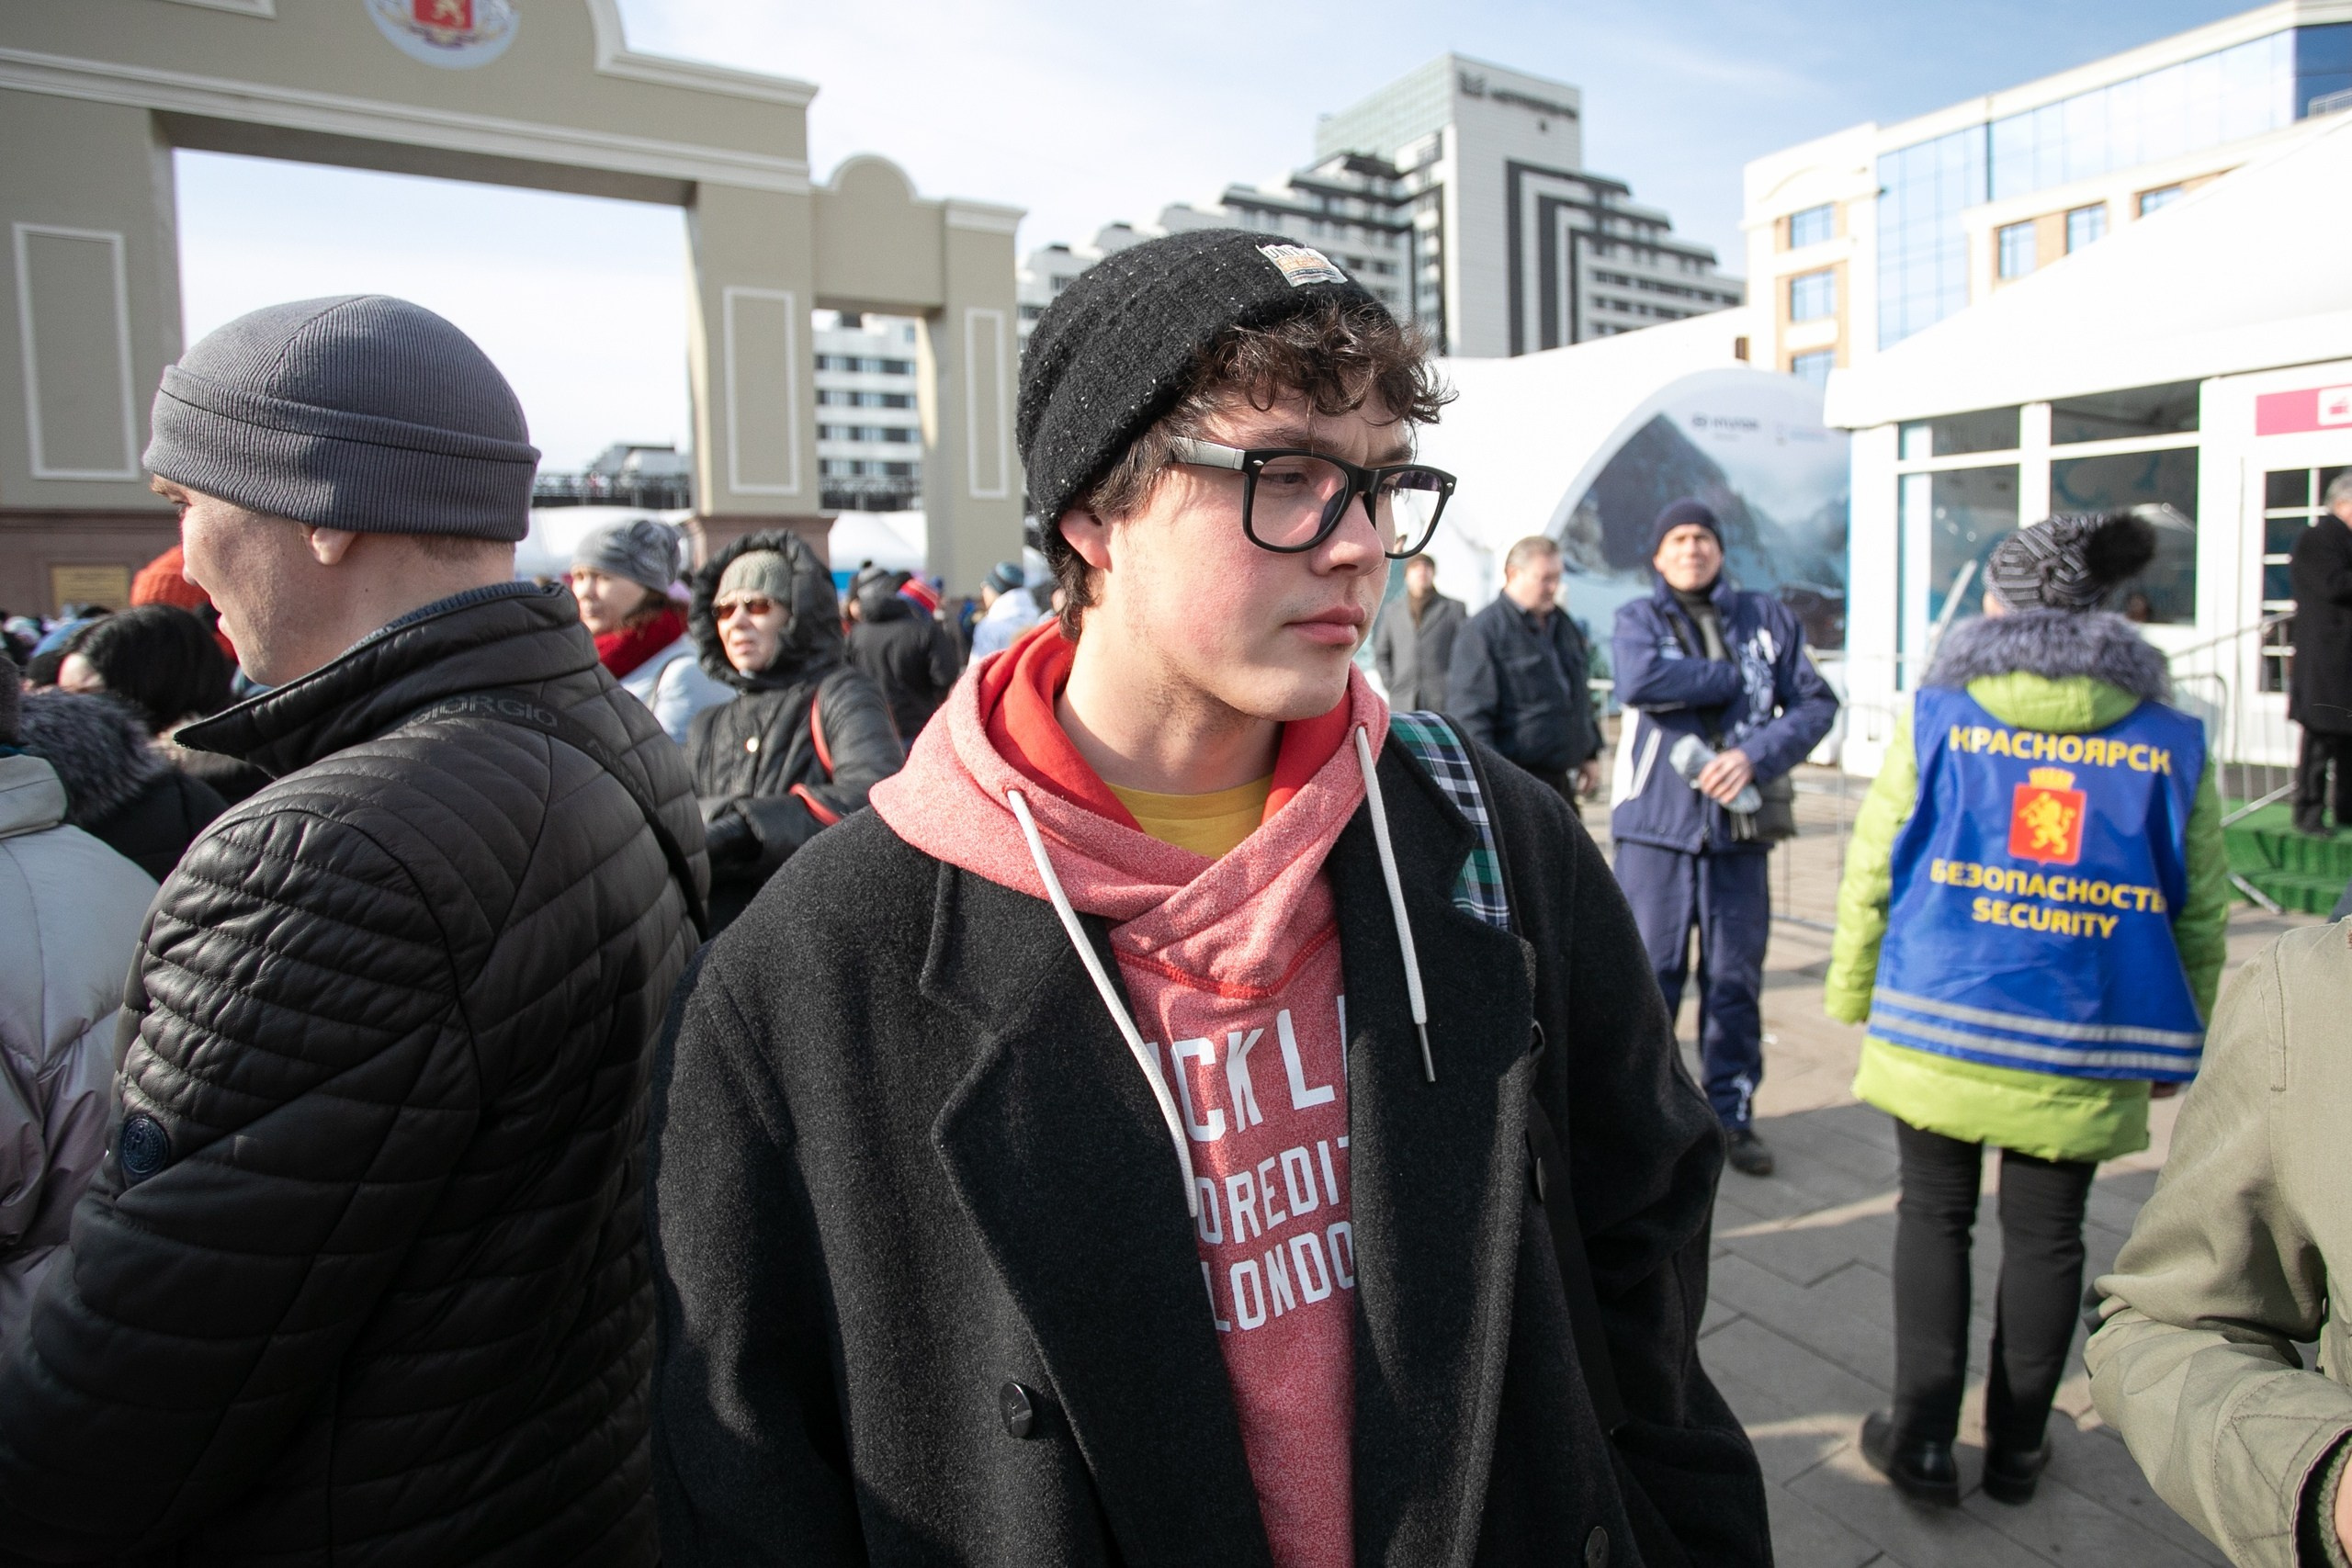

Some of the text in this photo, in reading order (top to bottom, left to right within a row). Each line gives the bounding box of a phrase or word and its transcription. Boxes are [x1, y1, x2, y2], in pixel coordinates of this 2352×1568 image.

[1949, 724, 2172, 776] КРАСНОЯРСК
[1930, 859, 2167, 914] БЕЗОПАСНОСТЬ
[1972, 897, 2119, 939] SECURITY
